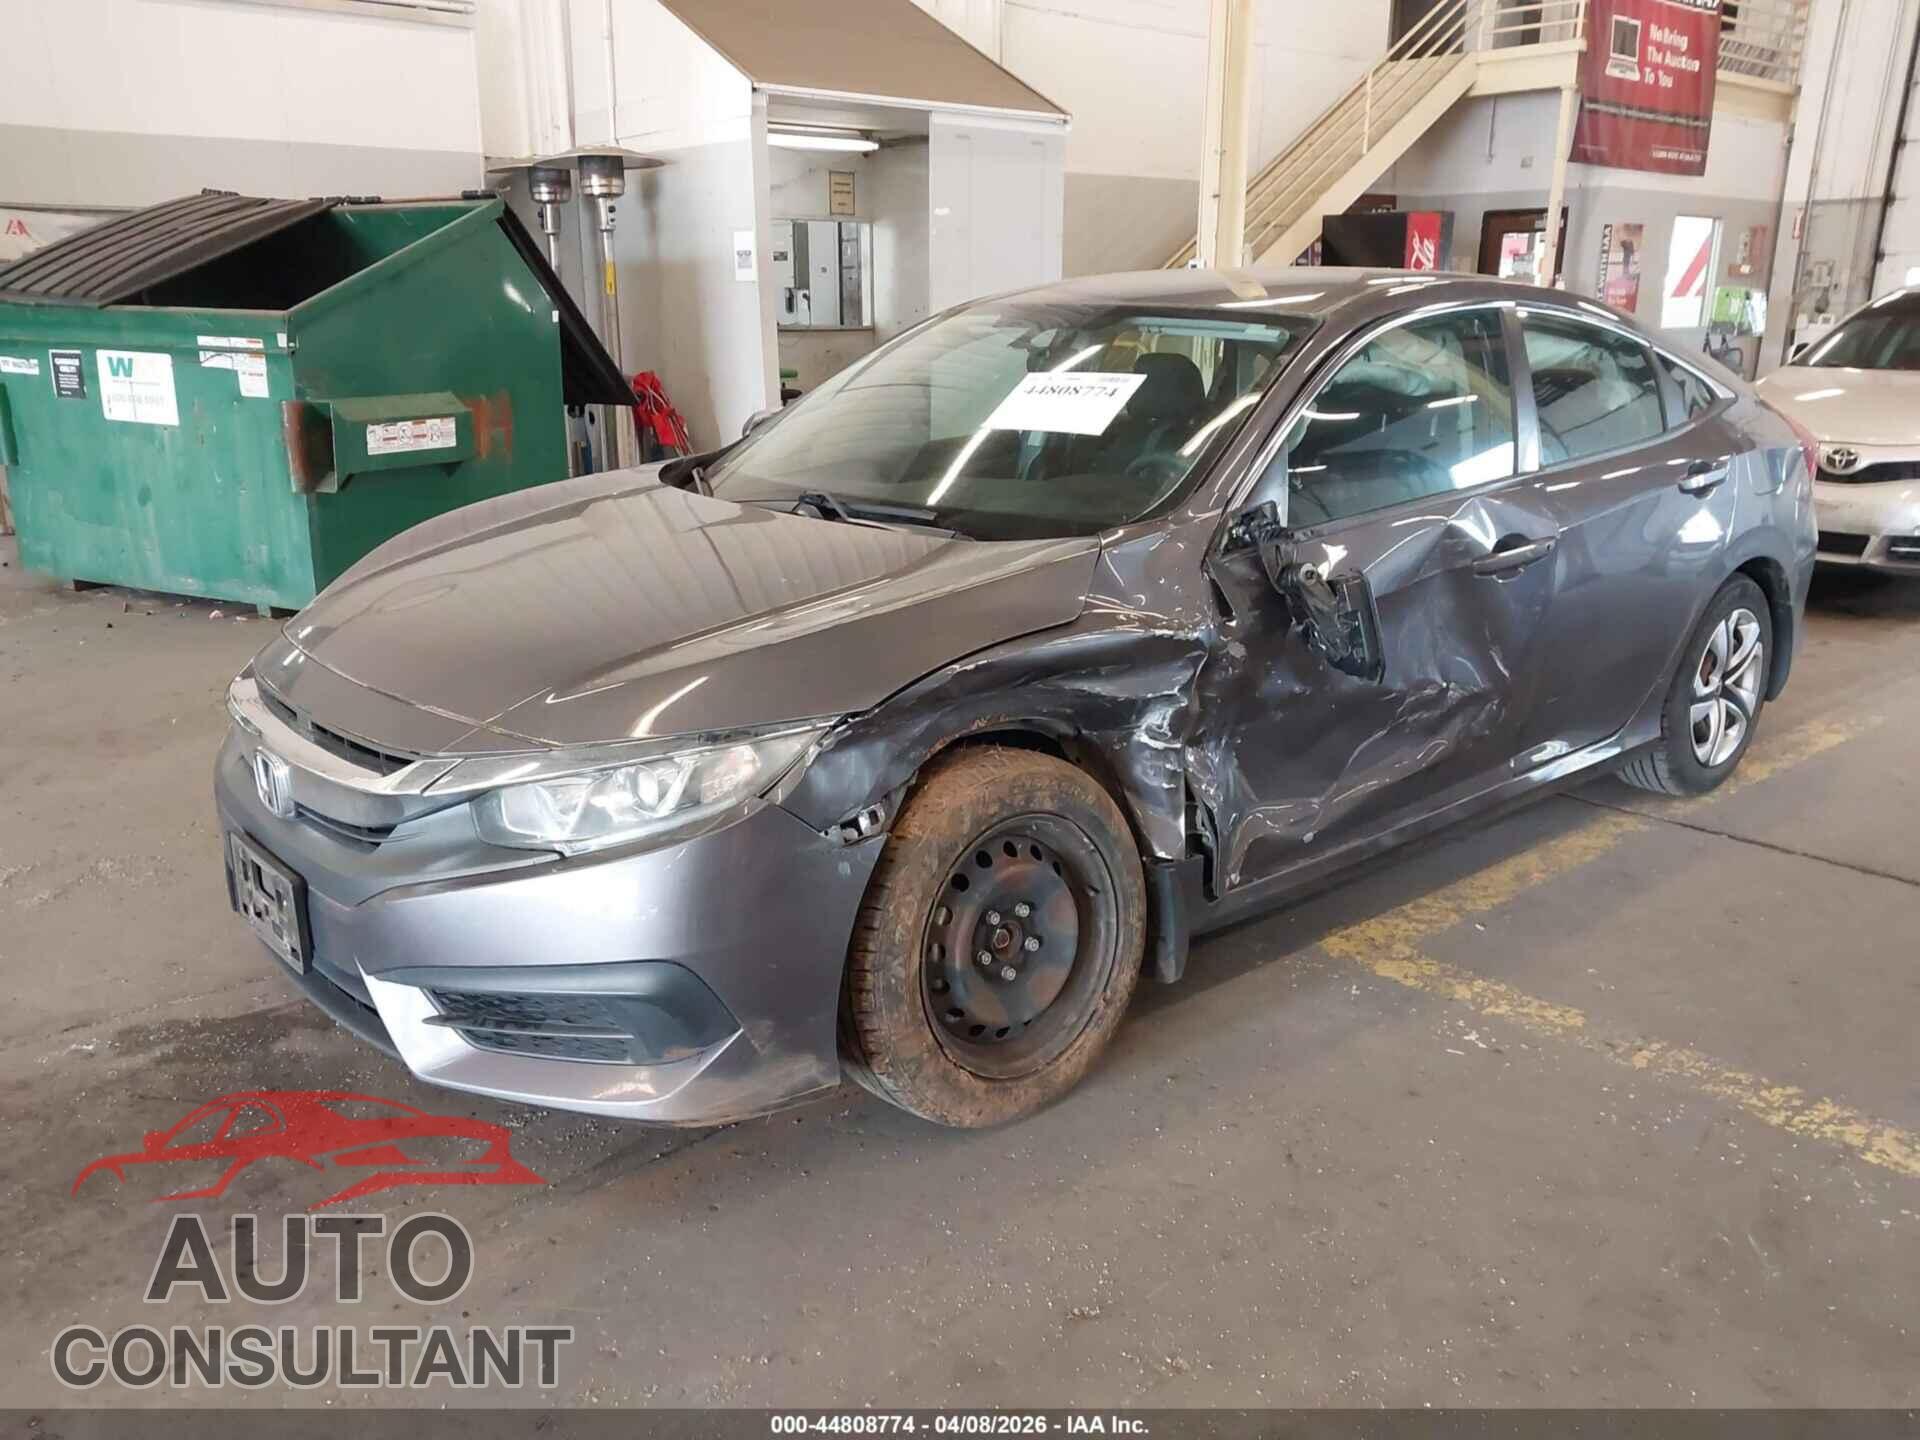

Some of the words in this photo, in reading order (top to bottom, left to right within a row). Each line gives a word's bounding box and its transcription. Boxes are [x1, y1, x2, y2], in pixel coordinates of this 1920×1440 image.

[1663, 27, 1688, 52] Bring
[1648, 46, 1662, 64] The
[1664, 50, 1700, 72] Auction
[1644, 67, 1656, 85] To
[1657, 69, 1674, 88] You
[1023, 384, 1120, 397] 44808774
